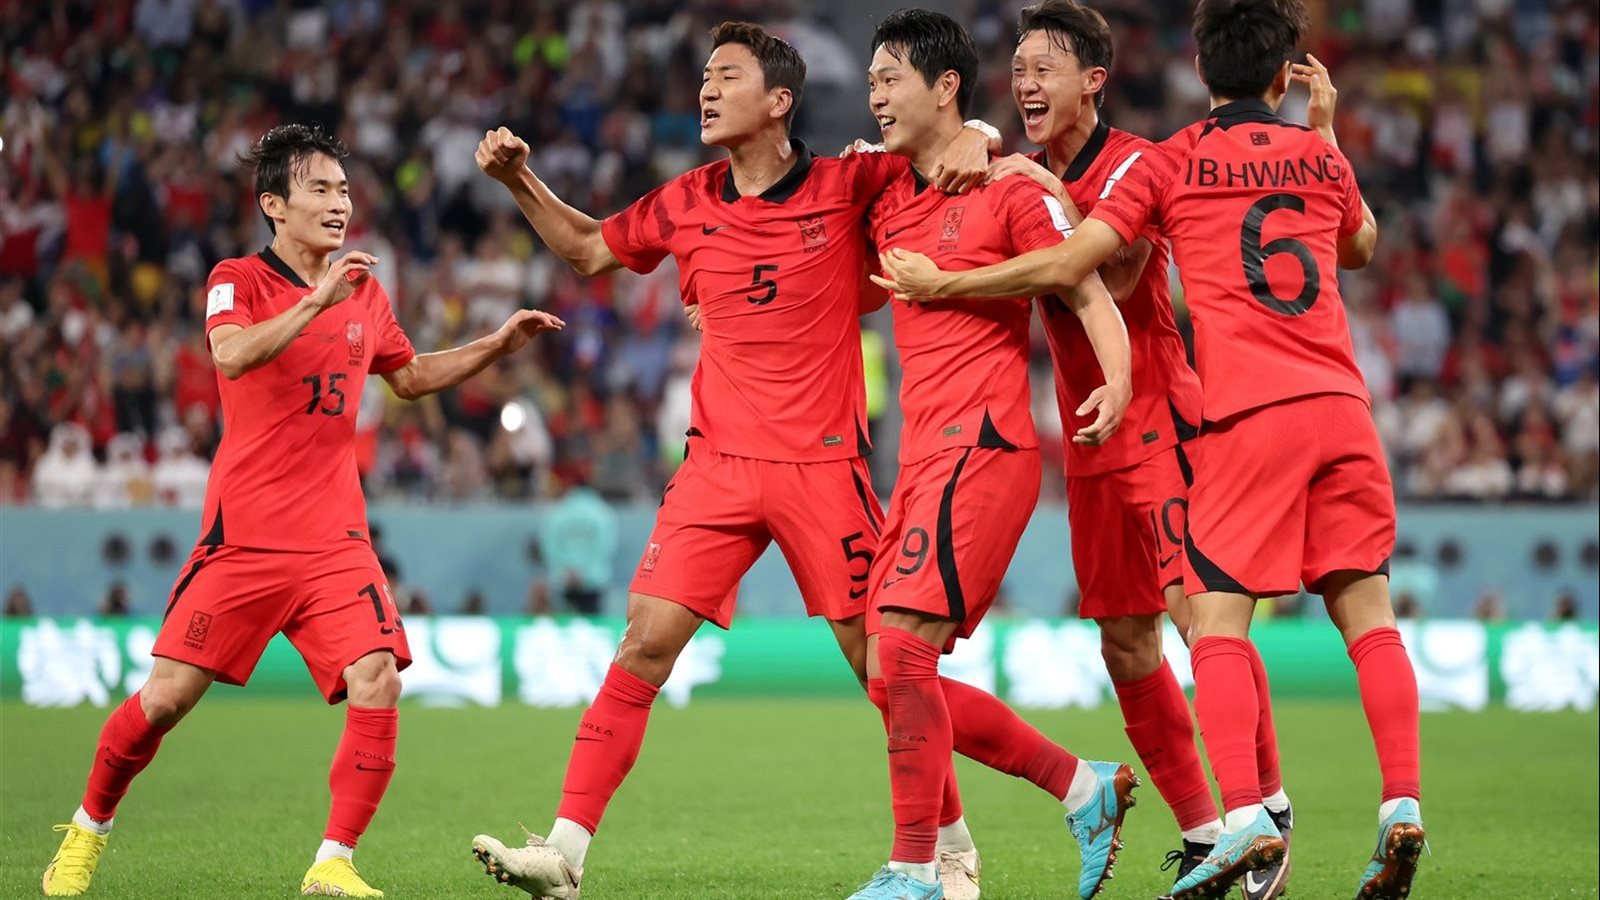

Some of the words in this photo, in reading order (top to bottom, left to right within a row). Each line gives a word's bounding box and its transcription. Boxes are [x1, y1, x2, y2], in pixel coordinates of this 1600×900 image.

[1226, 154, 1341, 188] HWANG
[1240, 192, 1321, 317] 6
[747, 264, 779, 306] 5
[302, 373, 347, 416] 15
[1150, 496, 1188, 555] 10
[840, 531, 874, 583] 5
[895, 526, 930, 576] 9
[358, 582, 402, 628] 1
[184, 641, 204, 651] KOREA
[579, 720, 614, 737] OREA
